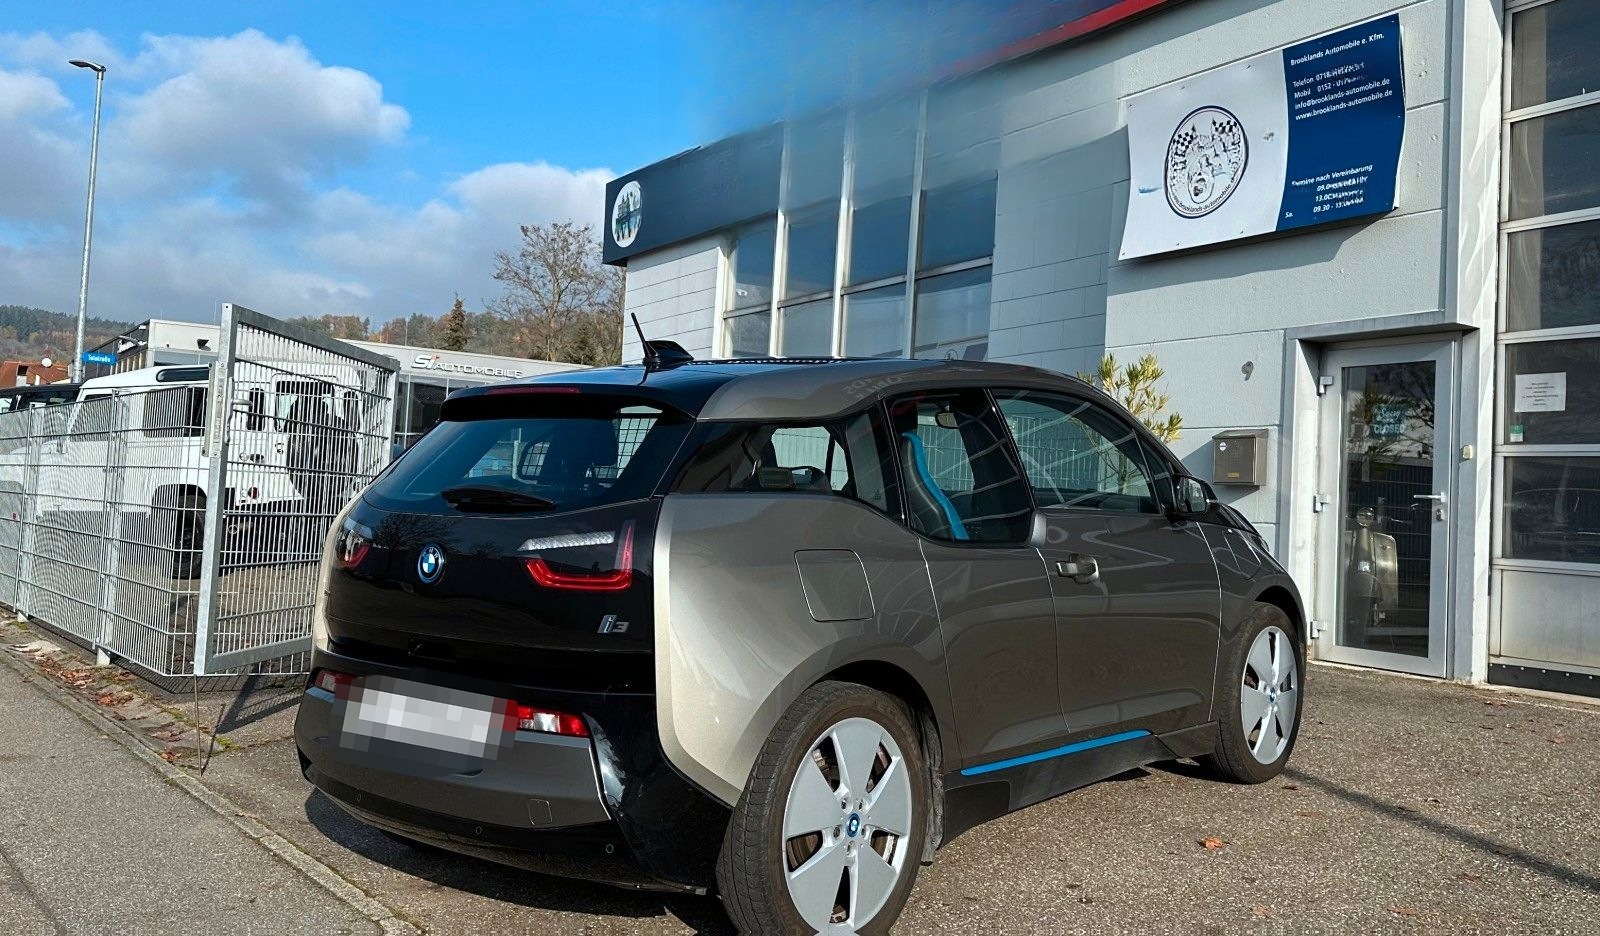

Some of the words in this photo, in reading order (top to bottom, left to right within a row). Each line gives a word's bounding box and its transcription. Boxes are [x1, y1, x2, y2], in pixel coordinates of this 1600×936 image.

[1290, 52, 1324, 66] Brooklands
[1325, 41, 1361, 56] Automobile
[1369, 33, 1385, 42] Kfm.
[1293, 77, 1314, 88] Telefon
[1294, 88, 1311, 99] Mobil
[1294, 78, 1390, 110] info@brooklands-automobile.de
[1295, 90, 1393, 120] www.brooklands-automobile.de
[1316, 173, 1331, 183] nach
[1331, 164, 1373, 179] Vereinbarung
[433, 362, 524, 379] AUTOMOBILE
[1241, 360, 1254, 381] 9
[1373, 423, 1405, 435] CLOSED
[597, 614, 630, 634] i3
